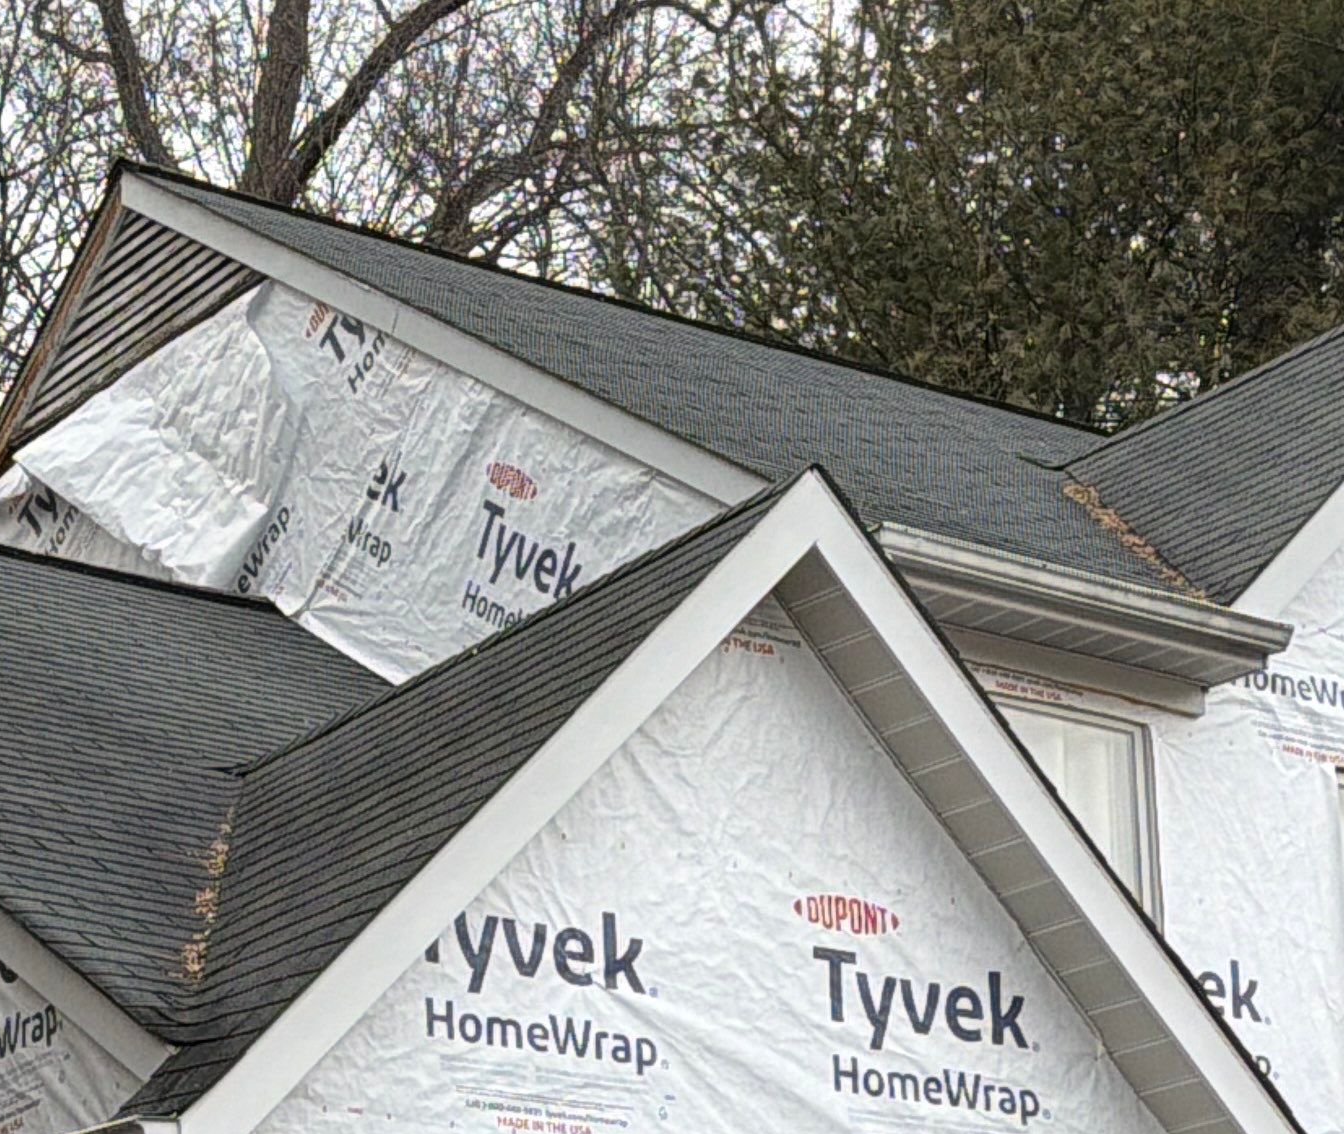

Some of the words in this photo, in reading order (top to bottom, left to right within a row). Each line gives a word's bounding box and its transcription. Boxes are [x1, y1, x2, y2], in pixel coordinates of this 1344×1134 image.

[237, 504, 291, 595] eWrap
[477, 500, 582, 600] Tyvek
[426, 911, 646, 994] yvek
[806, 895, 888, 934] DUPONT
[425, 998, 657, 1075] HomeWrap
[813, 946, 1031, 1051] Tyvek
[497, 1116, 530, 1131] MADE
[545, 1123, 566, 1134] THE
[833, 1055, 1040, 1121] HomeWrap
